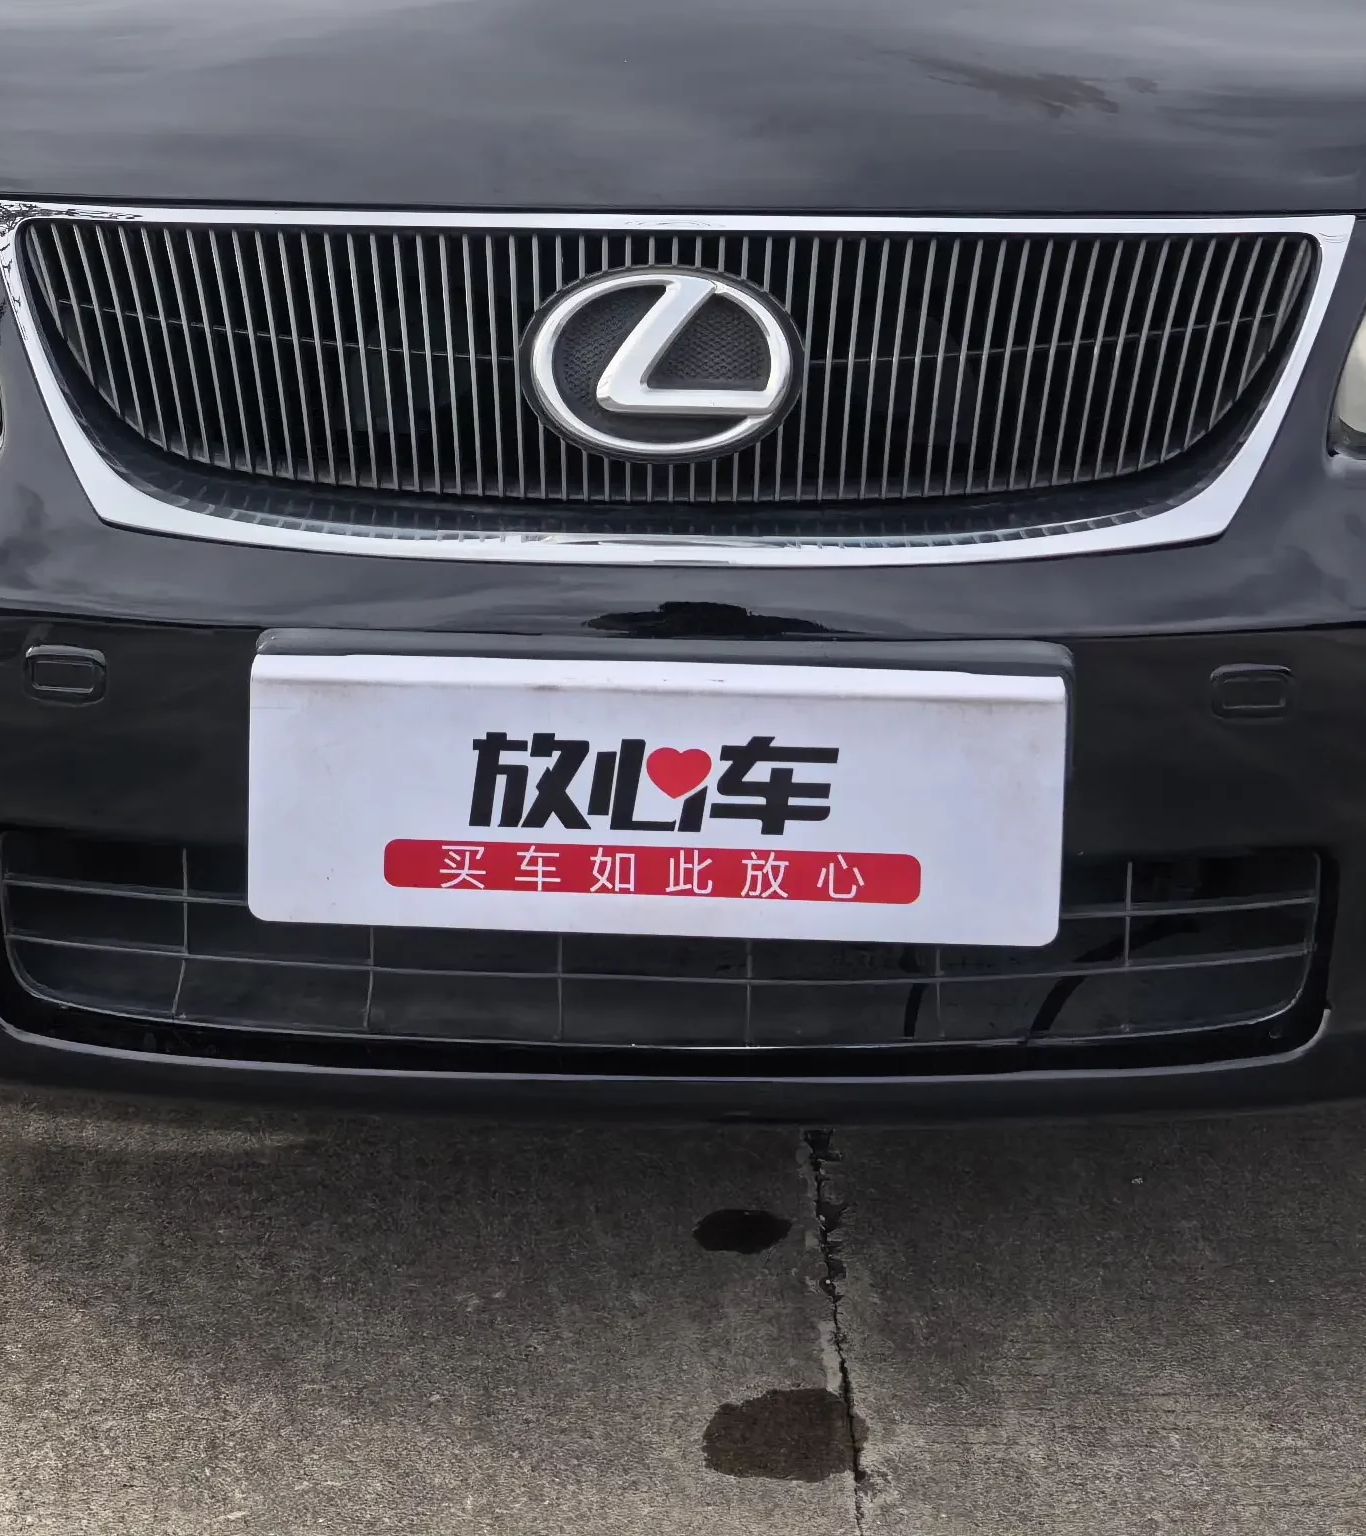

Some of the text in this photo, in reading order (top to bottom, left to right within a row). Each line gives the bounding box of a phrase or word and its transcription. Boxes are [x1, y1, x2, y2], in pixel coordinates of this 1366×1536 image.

[468, 731, 840, 836] 放心车
[439, 844, 866, 900] 买车如此放心
